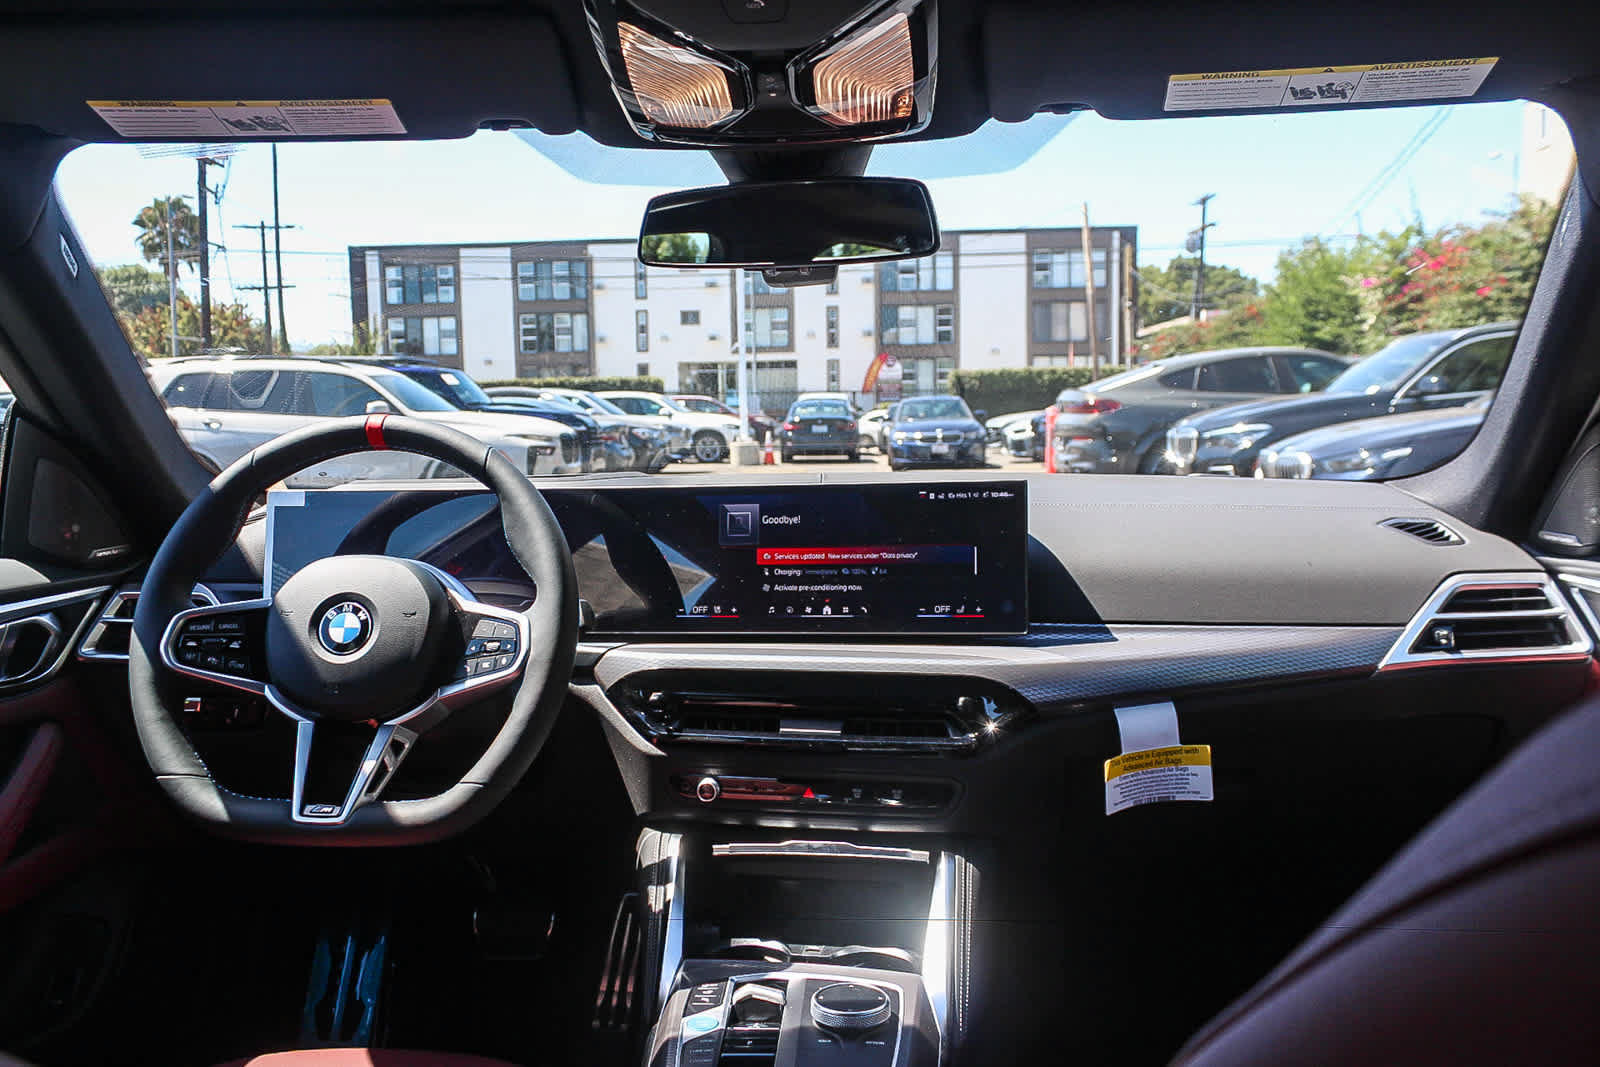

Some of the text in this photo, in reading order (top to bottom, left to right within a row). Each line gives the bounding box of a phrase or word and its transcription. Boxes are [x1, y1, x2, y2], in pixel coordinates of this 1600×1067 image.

[1369, 58, 1479, 72] AVERTISSEMENT
[1200, 71, 1261, 80] WARNING
[762, 514, 801, 526] Goodbye!
[774, 552, 799, 560] Services
[827, 552, 840, 560] New
[841, 552, 863, 560] services
[774, 584, 798, 592] Activate
[798, 584, 848, 593] pre-conditioning
[326, 603, 368, 621] BMW
[692, 604, 709, 614] OFF
[934, 604, 951, 614] OFF
[1121, 752, 1144, 765] Vehicle
[1151, 747, 1184, 760] Equipped
[1184, 747, 1200, 755] with
[1123, 758, 1154, 771] Advanced
[1166, 756, 1182, 766] Bags
